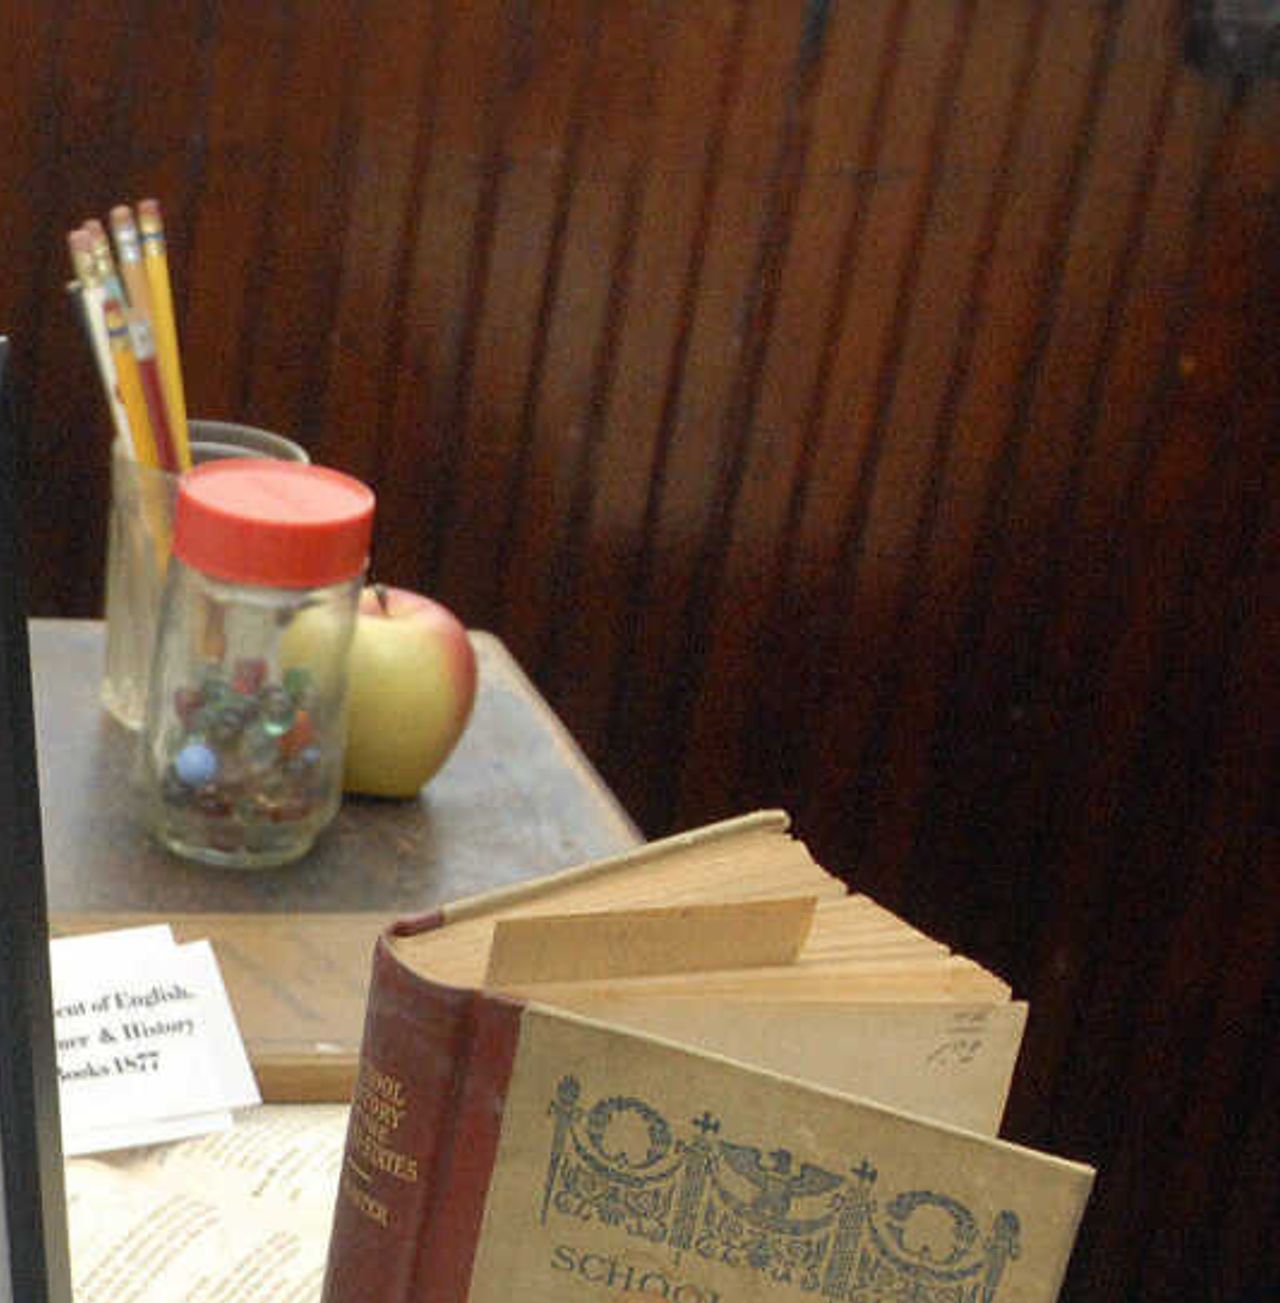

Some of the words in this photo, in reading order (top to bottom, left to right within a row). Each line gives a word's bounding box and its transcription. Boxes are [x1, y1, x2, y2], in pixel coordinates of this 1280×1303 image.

[98, 1026, 117, 1044] &
[121, 1017, 195, 1041] History
[113, 1050, 159, 1075] 1877
